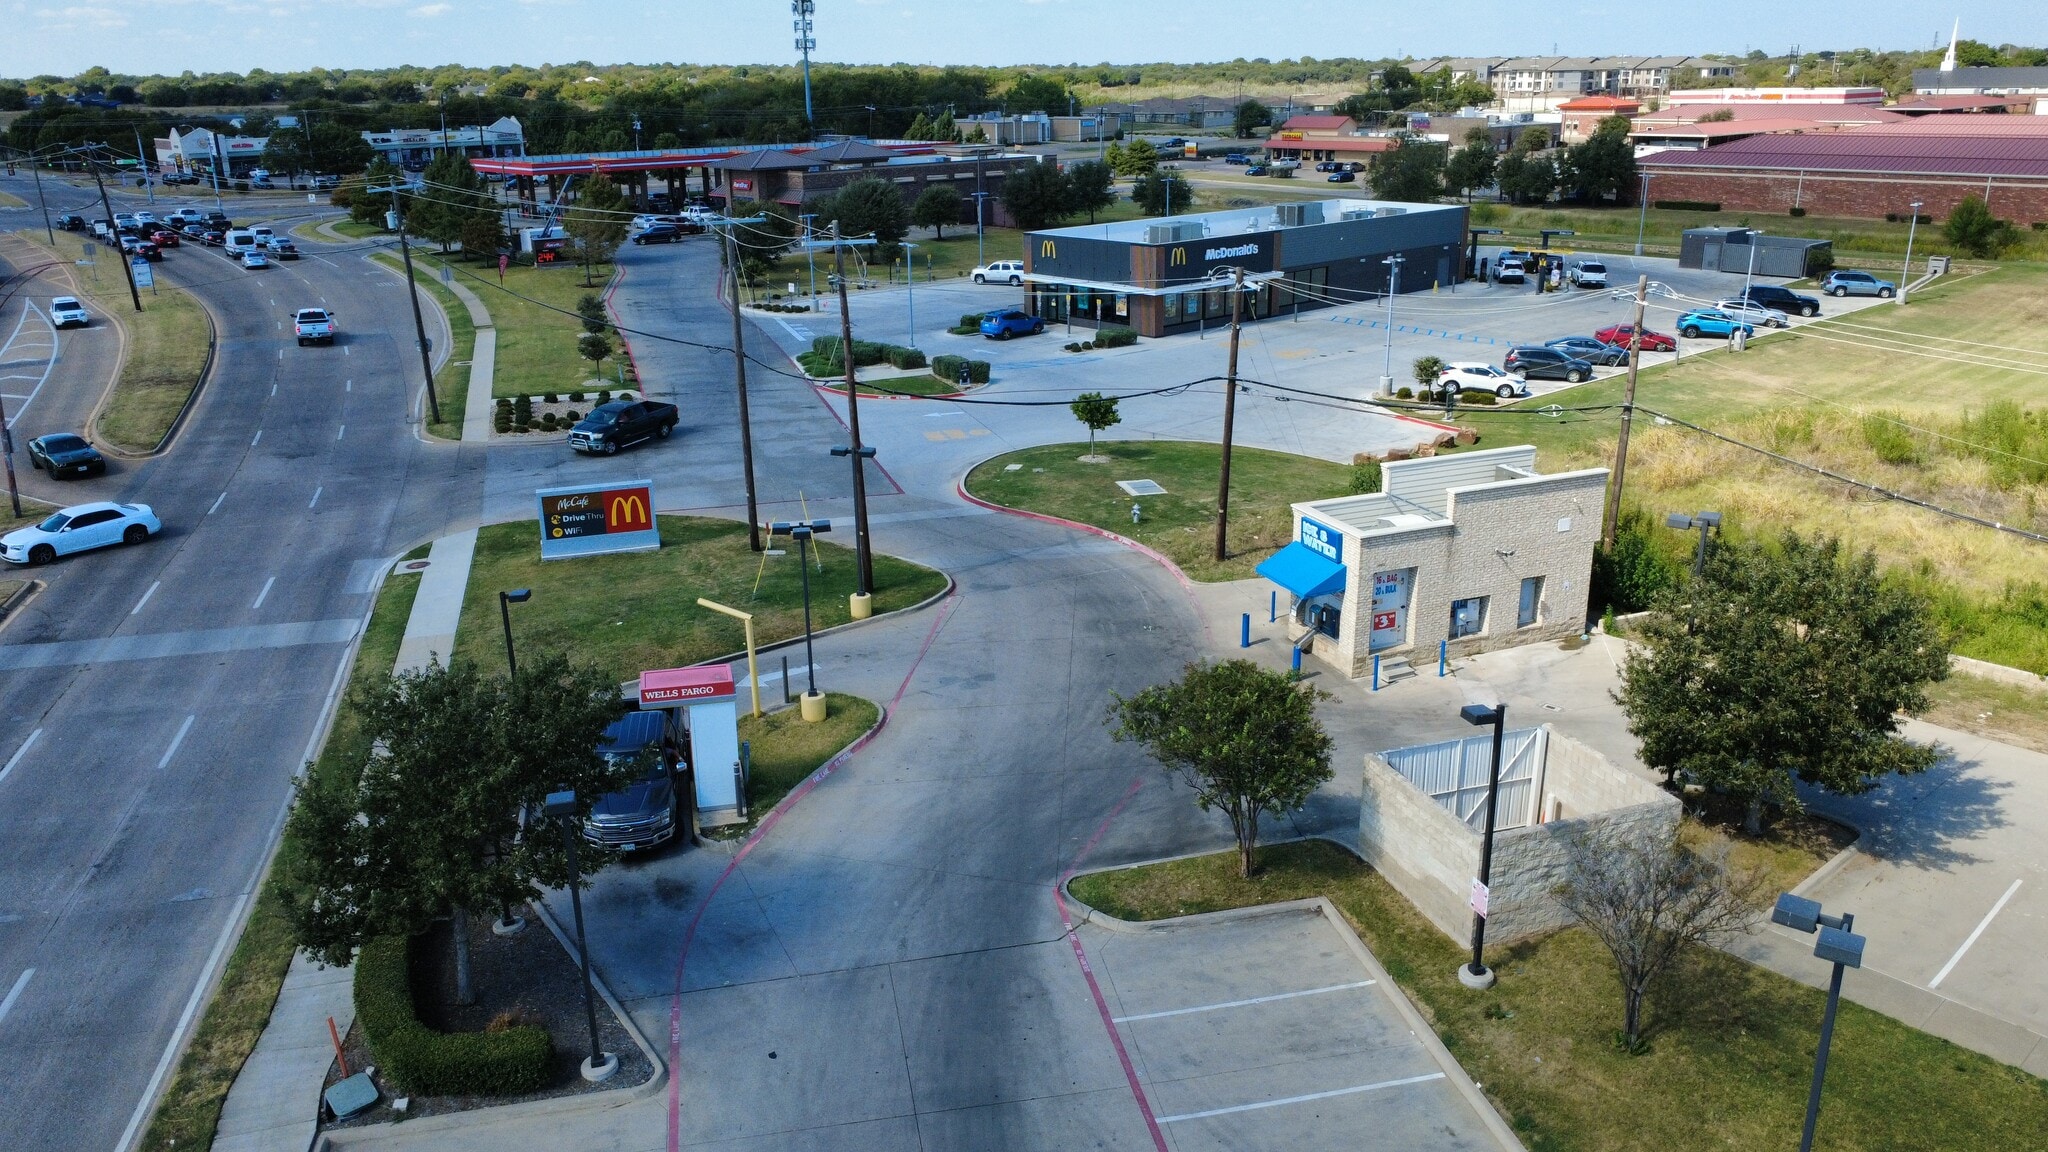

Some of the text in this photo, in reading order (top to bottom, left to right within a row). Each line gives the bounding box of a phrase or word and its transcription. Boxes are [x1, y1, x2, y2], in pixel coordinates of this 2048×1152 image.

[1205, 243, 1259, 260] McDonald's
[558, 495, 589, 511] McCafé
[562, 512, 605, 523] Drive Thru
[1303, 532, 1337, 560] WATER
[1386, 573, 1398, 583] BAG
[644, 686, 714, 699] WELLS FARGO
